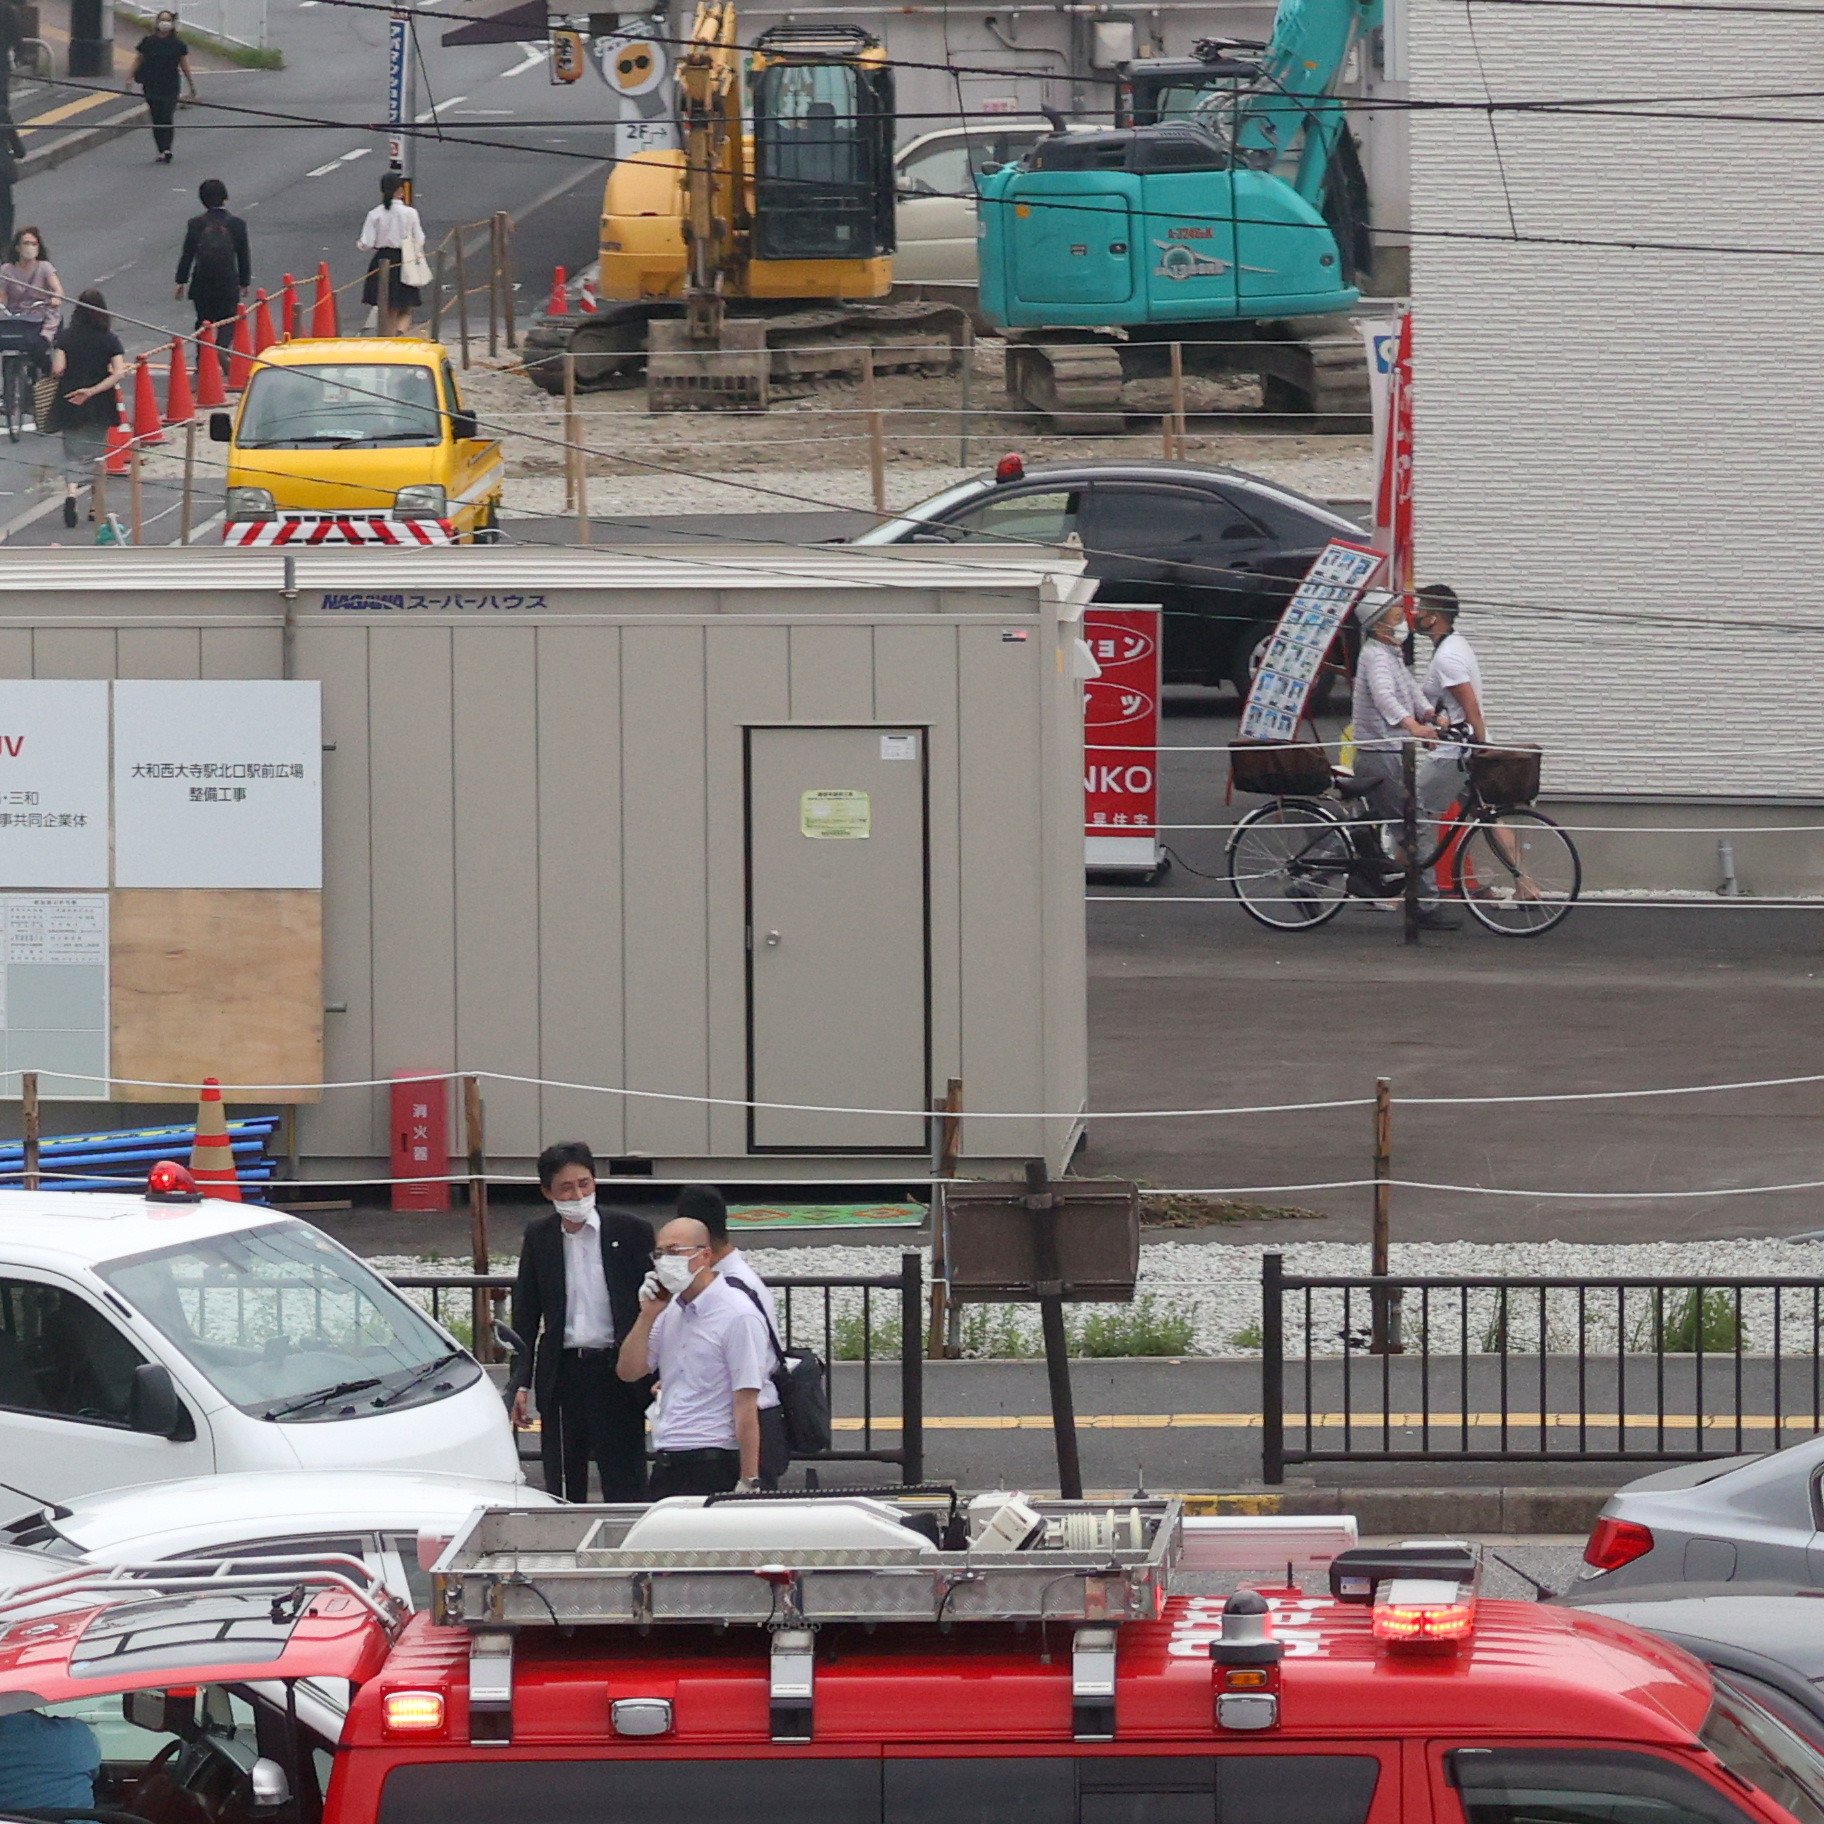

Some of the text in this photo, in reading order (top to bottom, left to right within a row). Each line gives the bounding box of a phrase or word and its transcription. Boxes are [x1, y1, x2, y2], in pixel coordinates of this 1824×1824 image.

[407, 594, 548, 610] スーパーハウス
[131, 763, 304, 780] 大和西大寺駅北口駅前広場
[189, 786, 247, 802] 整備工事
[413, 1103, 428, 1160] 消火器
